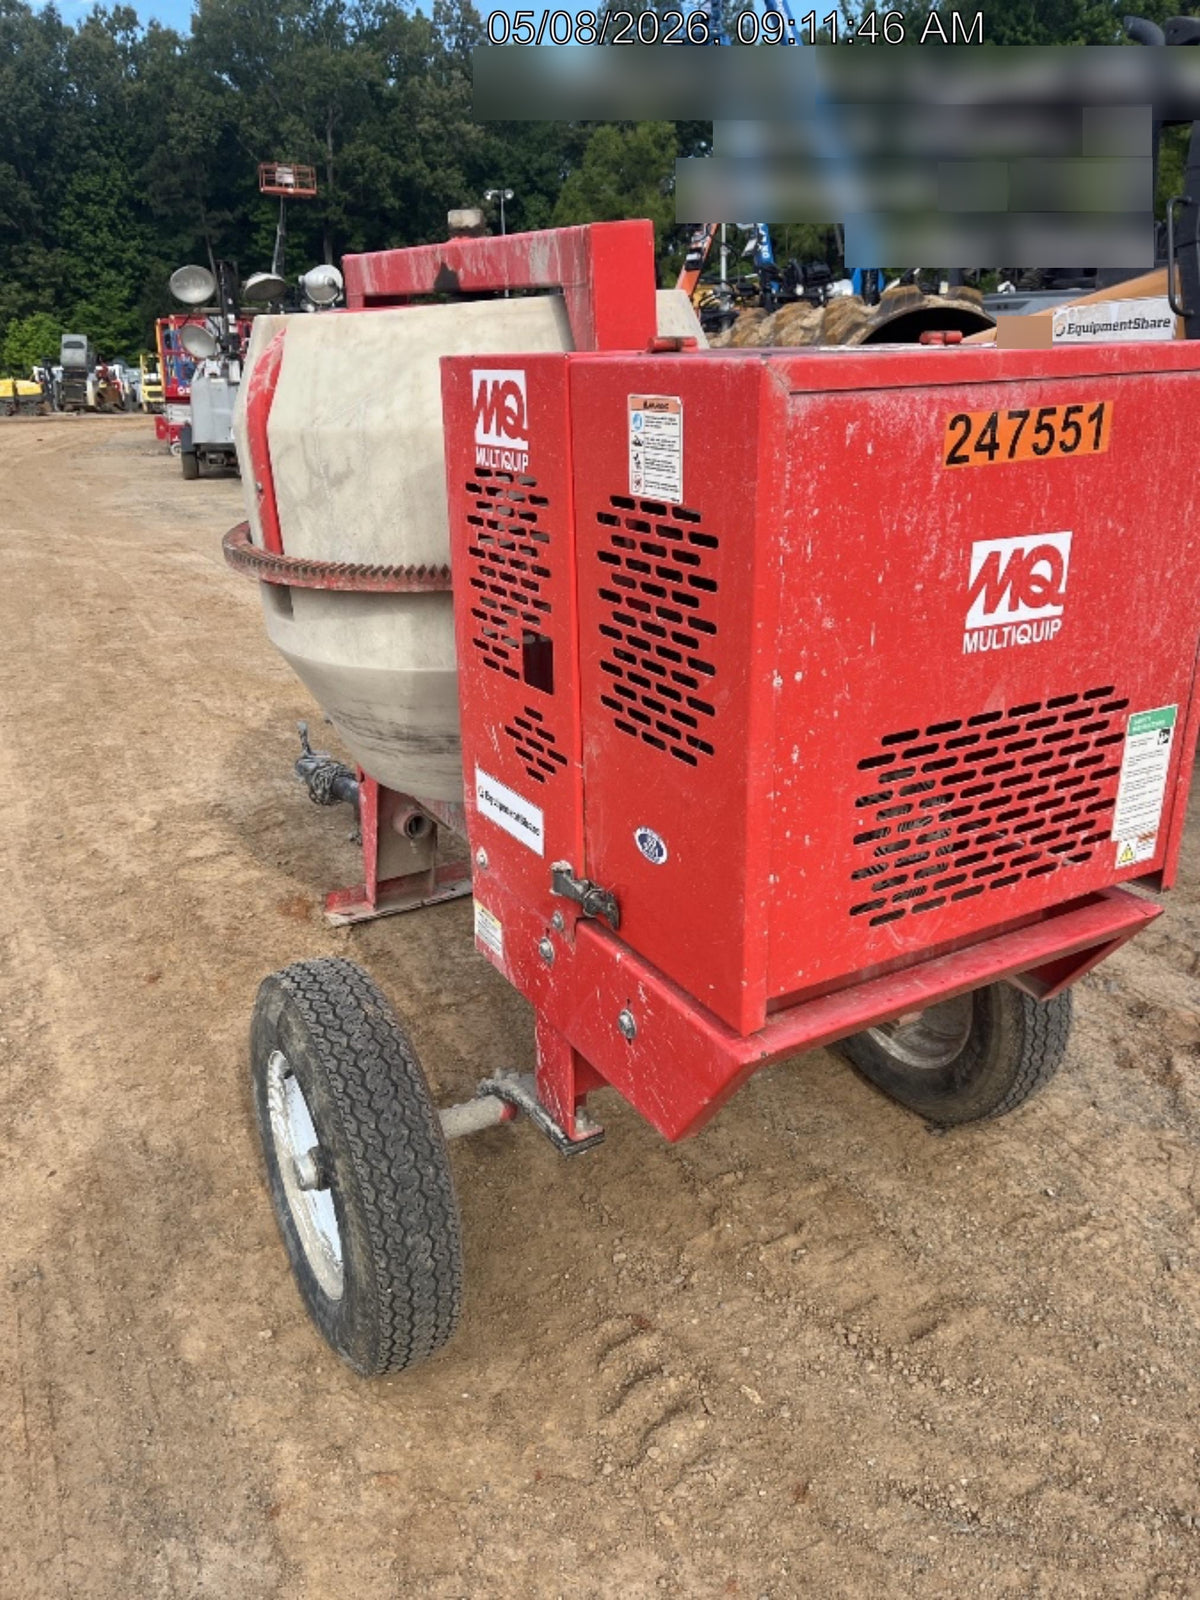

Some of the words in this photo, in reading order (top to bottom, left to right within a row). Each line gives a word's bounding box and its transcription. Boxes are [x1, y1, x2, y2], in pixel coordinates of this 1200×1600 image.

[1066, 317, 1171, 336] EquipmentShare
[473, 379, 528, 440] MQ
[946, 402, 1105, 466] 247551
[475, 446, 529, 473] MULTIQUIP
[966, 543, 1067, 615] MQ
[963, 618, 1062, 655] MULTIQUIP
